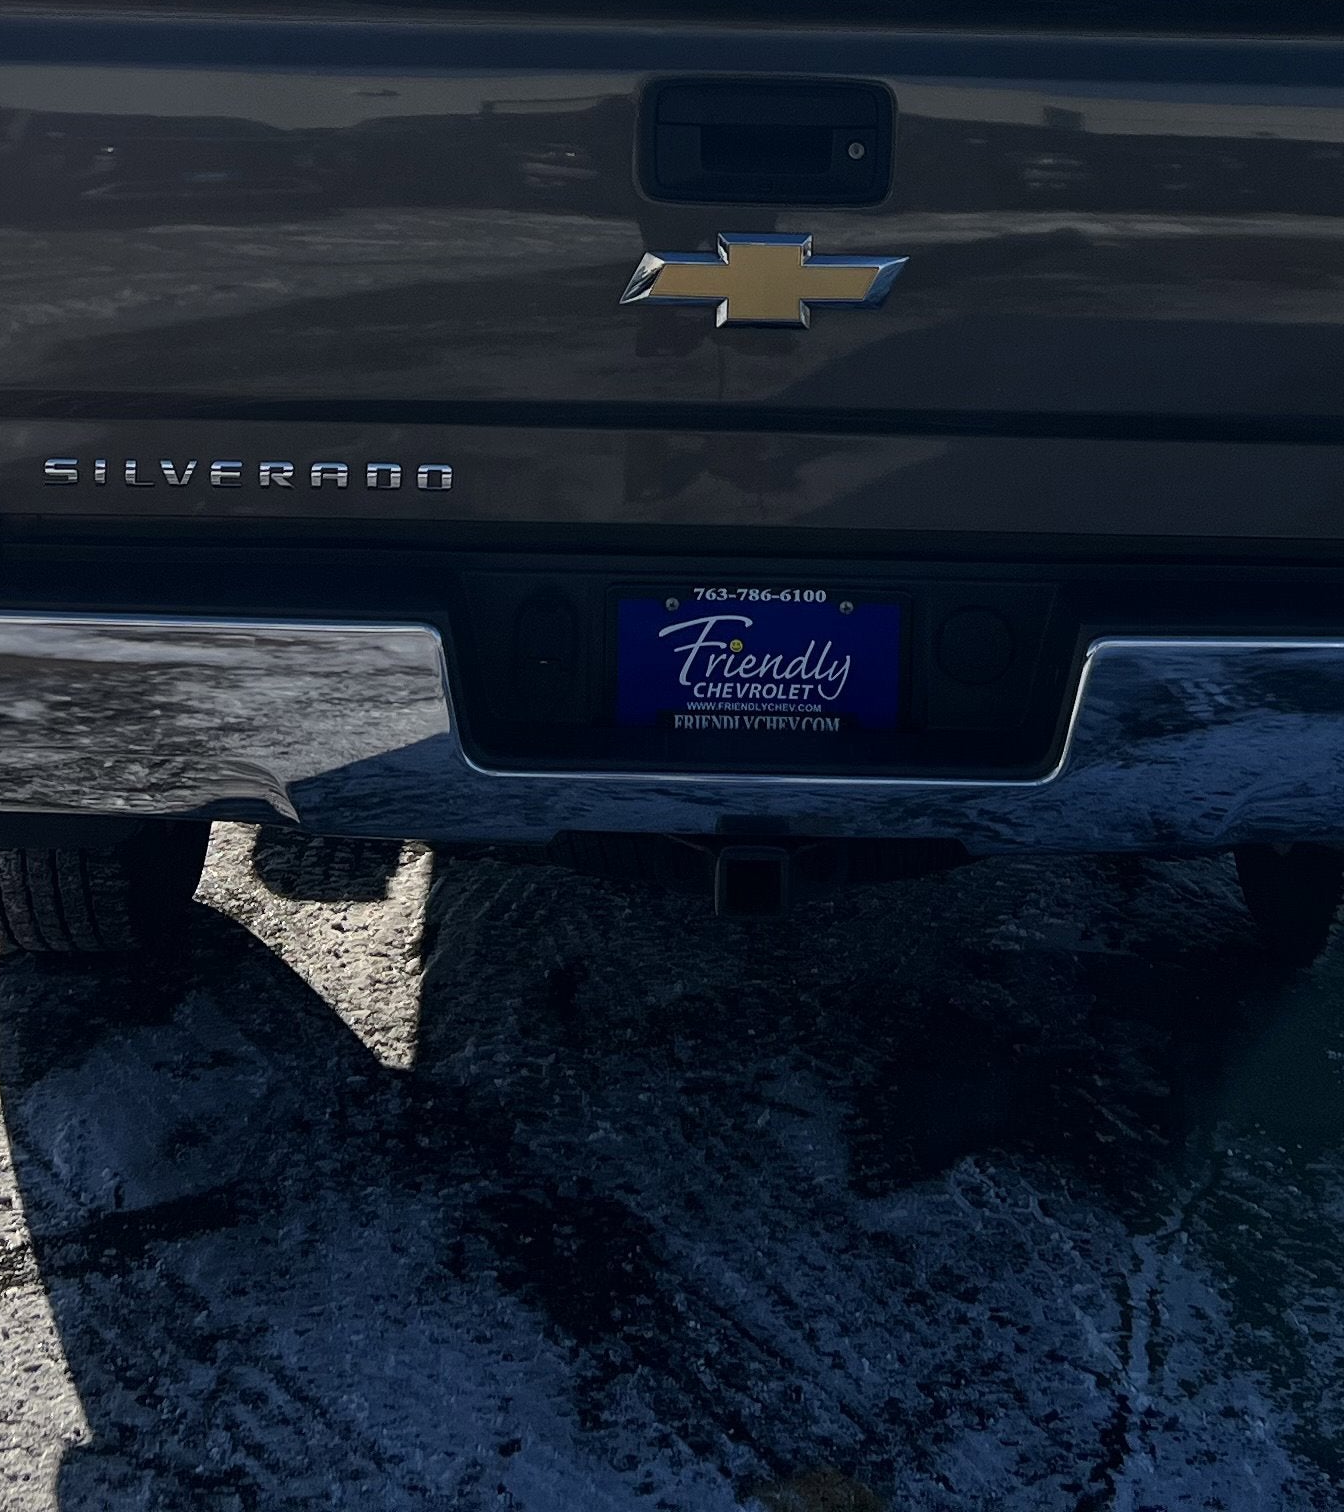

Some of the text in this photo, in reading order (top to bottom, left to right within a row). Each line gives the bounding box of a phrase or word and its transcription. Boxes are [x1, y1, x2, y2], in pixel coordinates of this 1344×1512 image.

[44, 458, 454, 489] SILVERADO
[693, 588, 827, 603] 763-786-6100
[658, 614, 851, 701] Friendly
[693, 681, 814, 700] CHEVROLET
[687, 701, 822, 713] WWW.FRIENDLYCHEV.COM
[674, 714, 841, 732] FRIENDLYCHEVCOM
